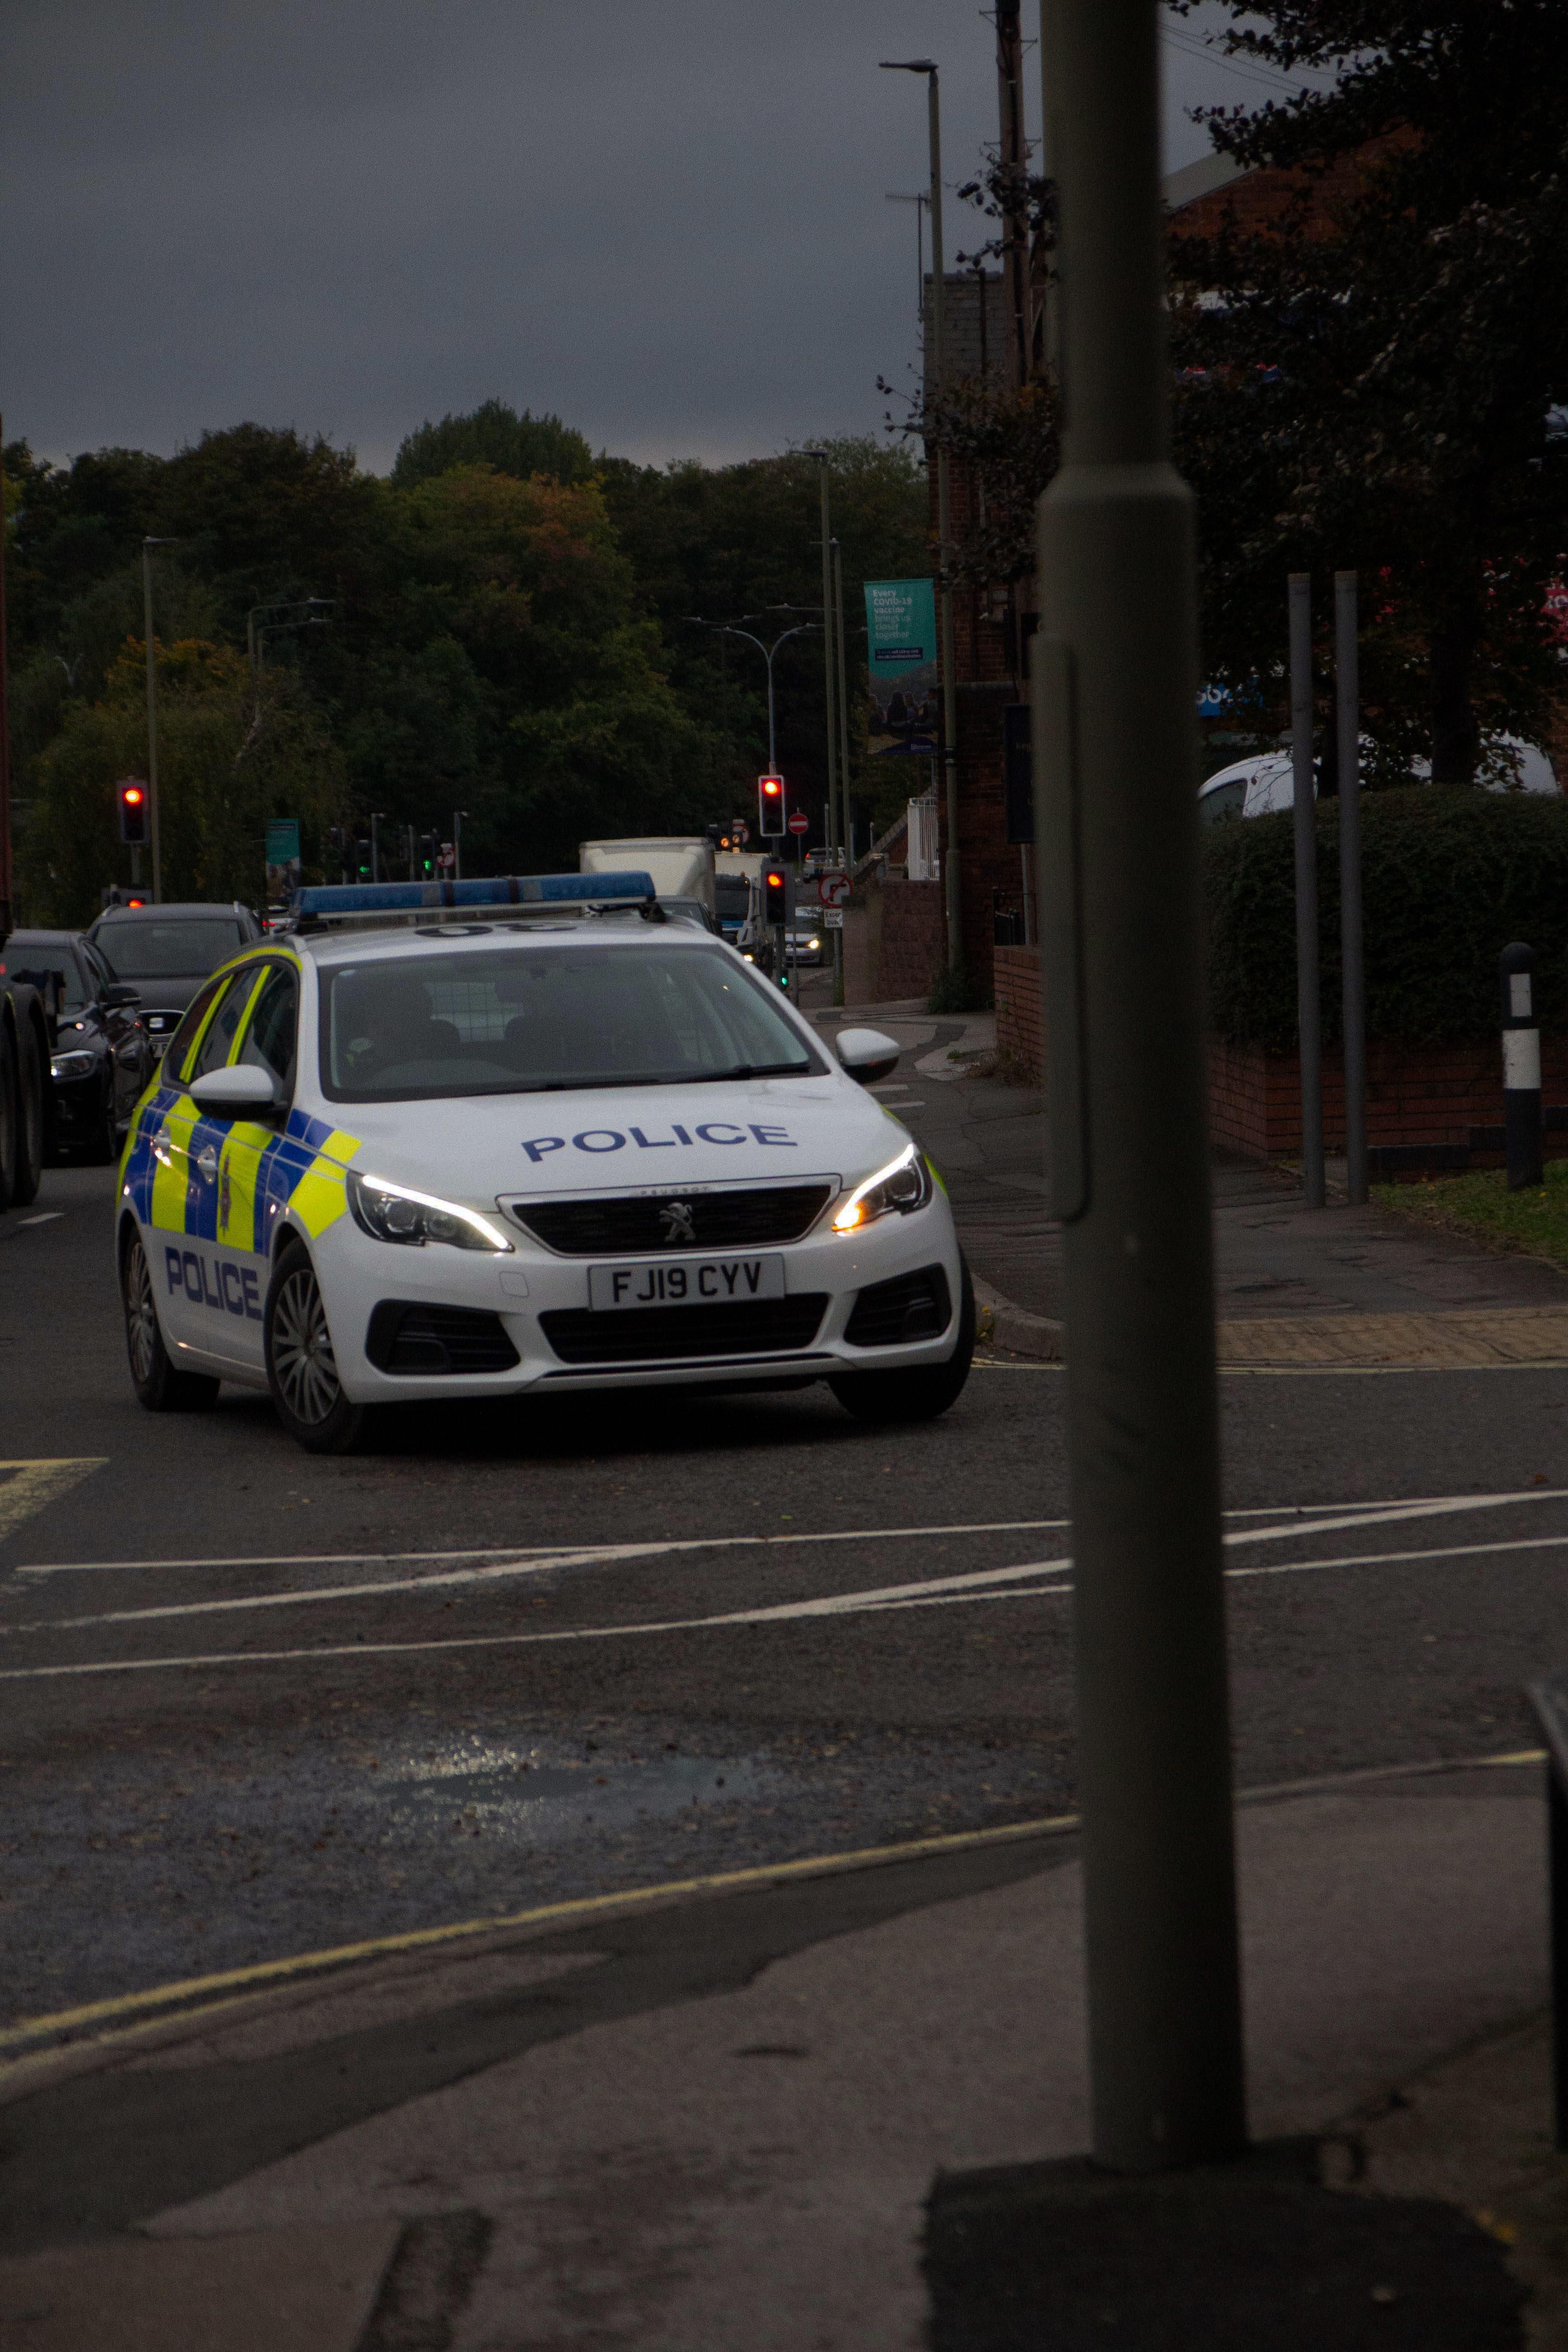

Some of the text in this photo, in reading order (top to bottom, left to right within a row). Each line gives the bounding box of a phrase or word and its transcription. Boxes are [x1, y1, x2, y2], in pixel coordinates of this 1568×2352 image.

[521, 1123, 798, 1162] POLICE
[640, 1186, 709, 1196] PEUGEOT
[165, 1246, 262, 1321] POLICE
[612, 1261, 761, 1302] FJ19 CYV
